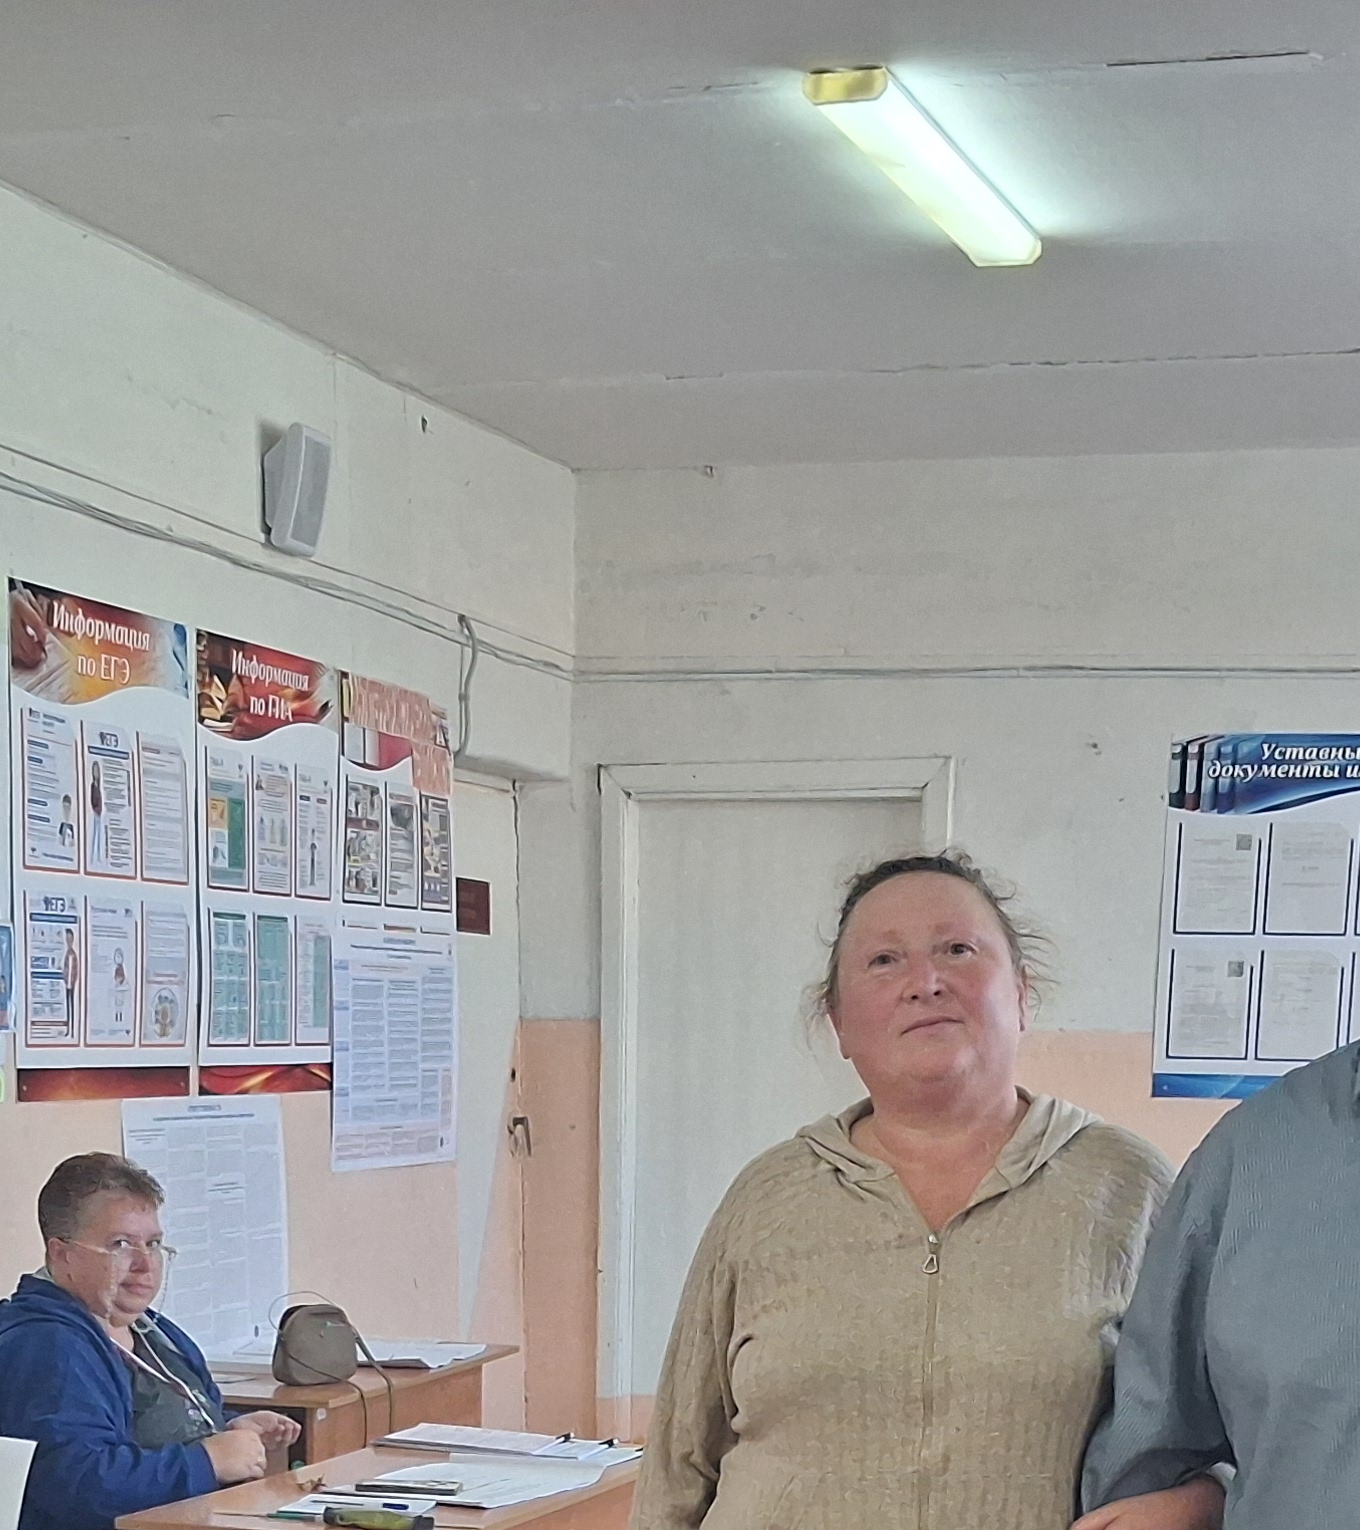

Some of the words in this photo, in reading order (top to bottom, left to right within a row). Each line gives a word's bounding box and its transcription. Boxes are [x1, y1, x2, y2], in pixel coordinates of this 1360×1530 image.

[53, 601, 151, 652] Информация
[77, 655, 97, 677] по
[100, 653, 131, 685] ЕГЭ
[232, 648, 309, 692] Информация
[249, 695, 266, 716] по
[1208, 760, 1340, 783] документы
